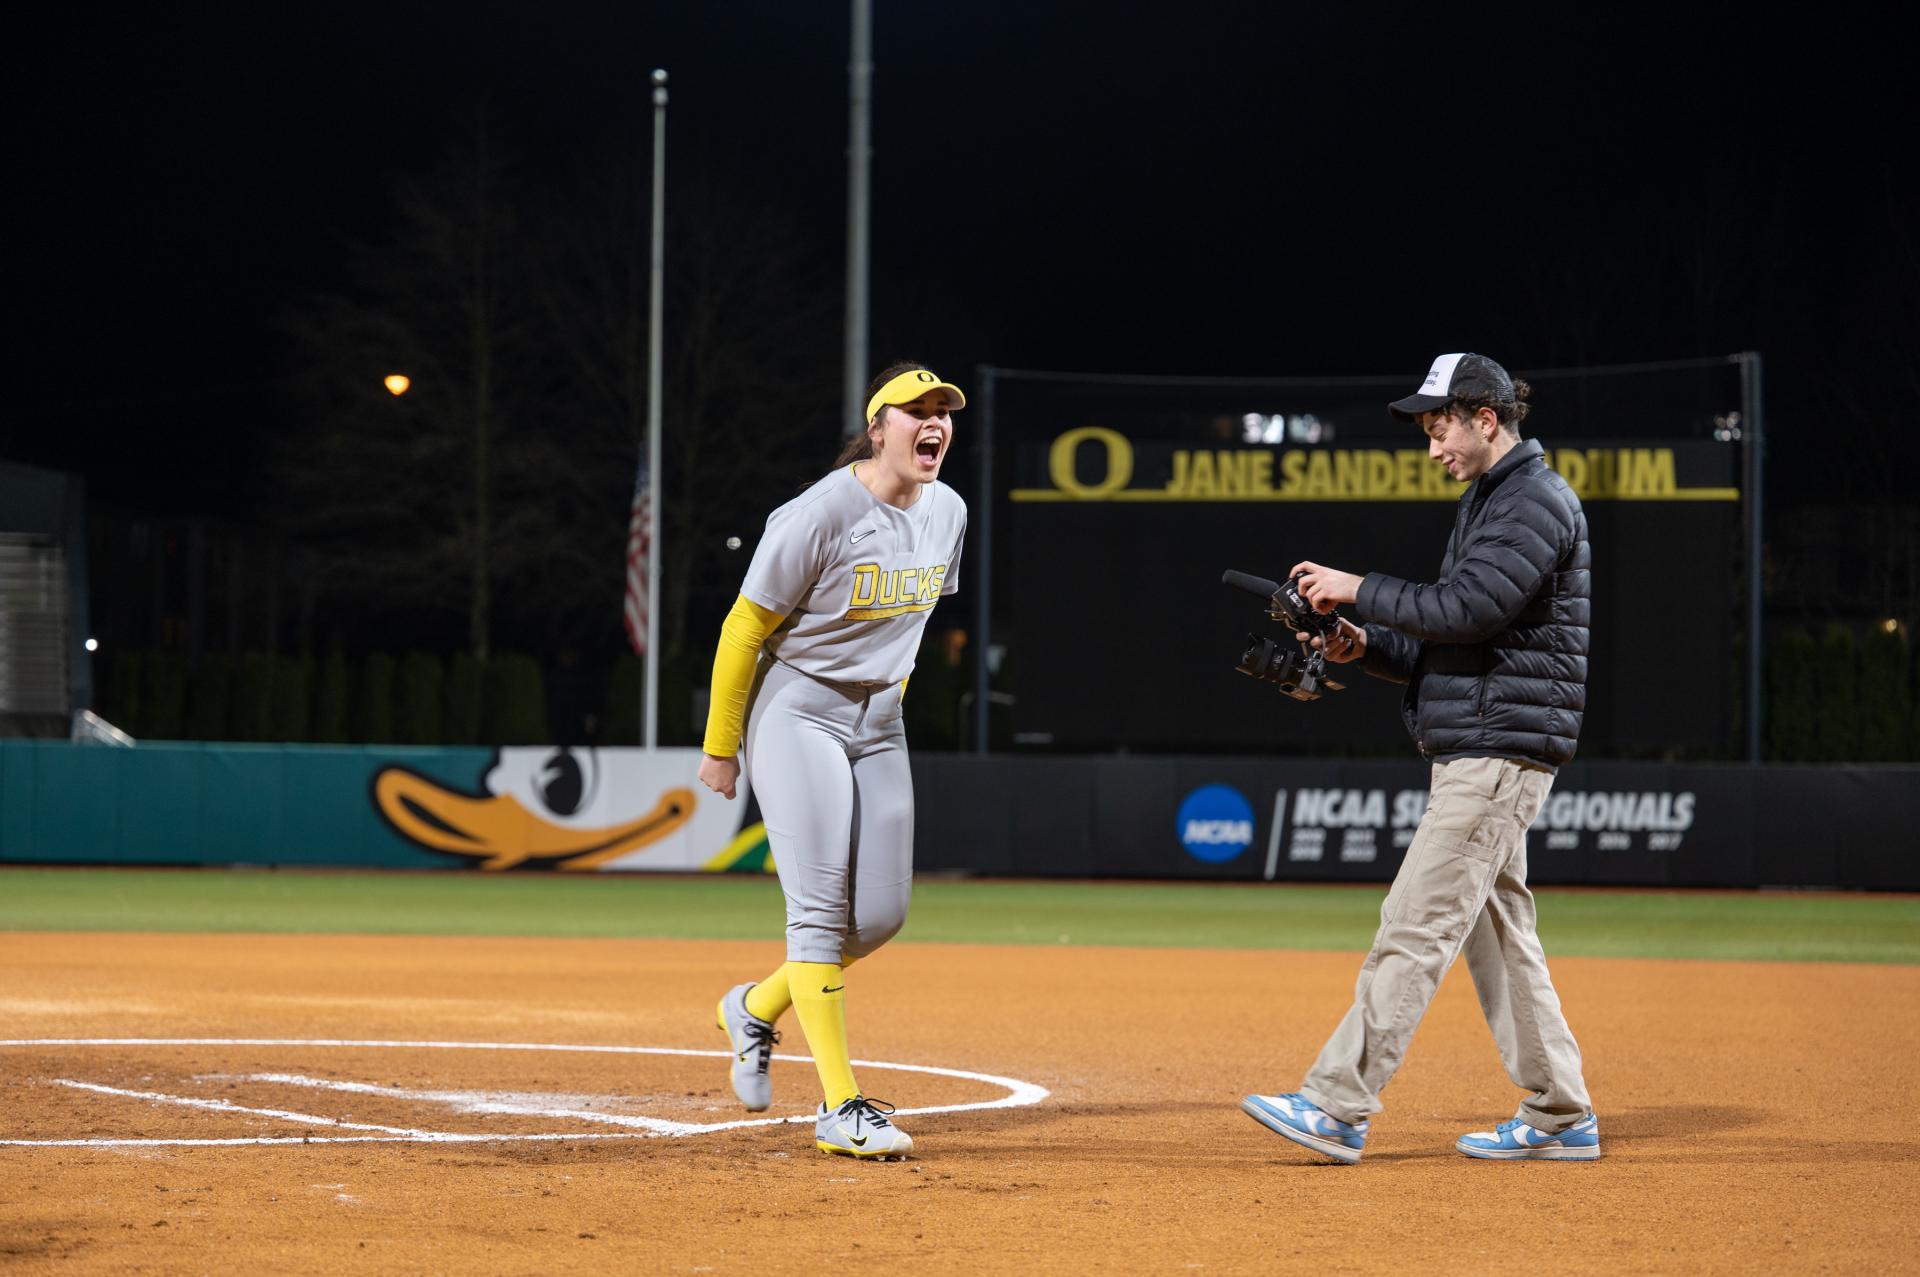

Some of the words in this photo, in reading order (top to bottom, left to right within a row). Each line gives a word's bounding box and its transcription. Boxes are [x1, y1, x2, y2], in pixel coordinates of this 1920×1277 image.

[917, 372, 934, 382] O
[1049, 427, 1134, 500] O
[1166, 450, 1274, 496] JANE
[1546, 448, 1677, 495] DIUM
[850, 562, 946, 607] DUCKS
[1294, 789, 1387, 829] NCAA
[1530, 791, 1696, 831] EGIONALS
[1183, 819, 1252, 845] NCAA
